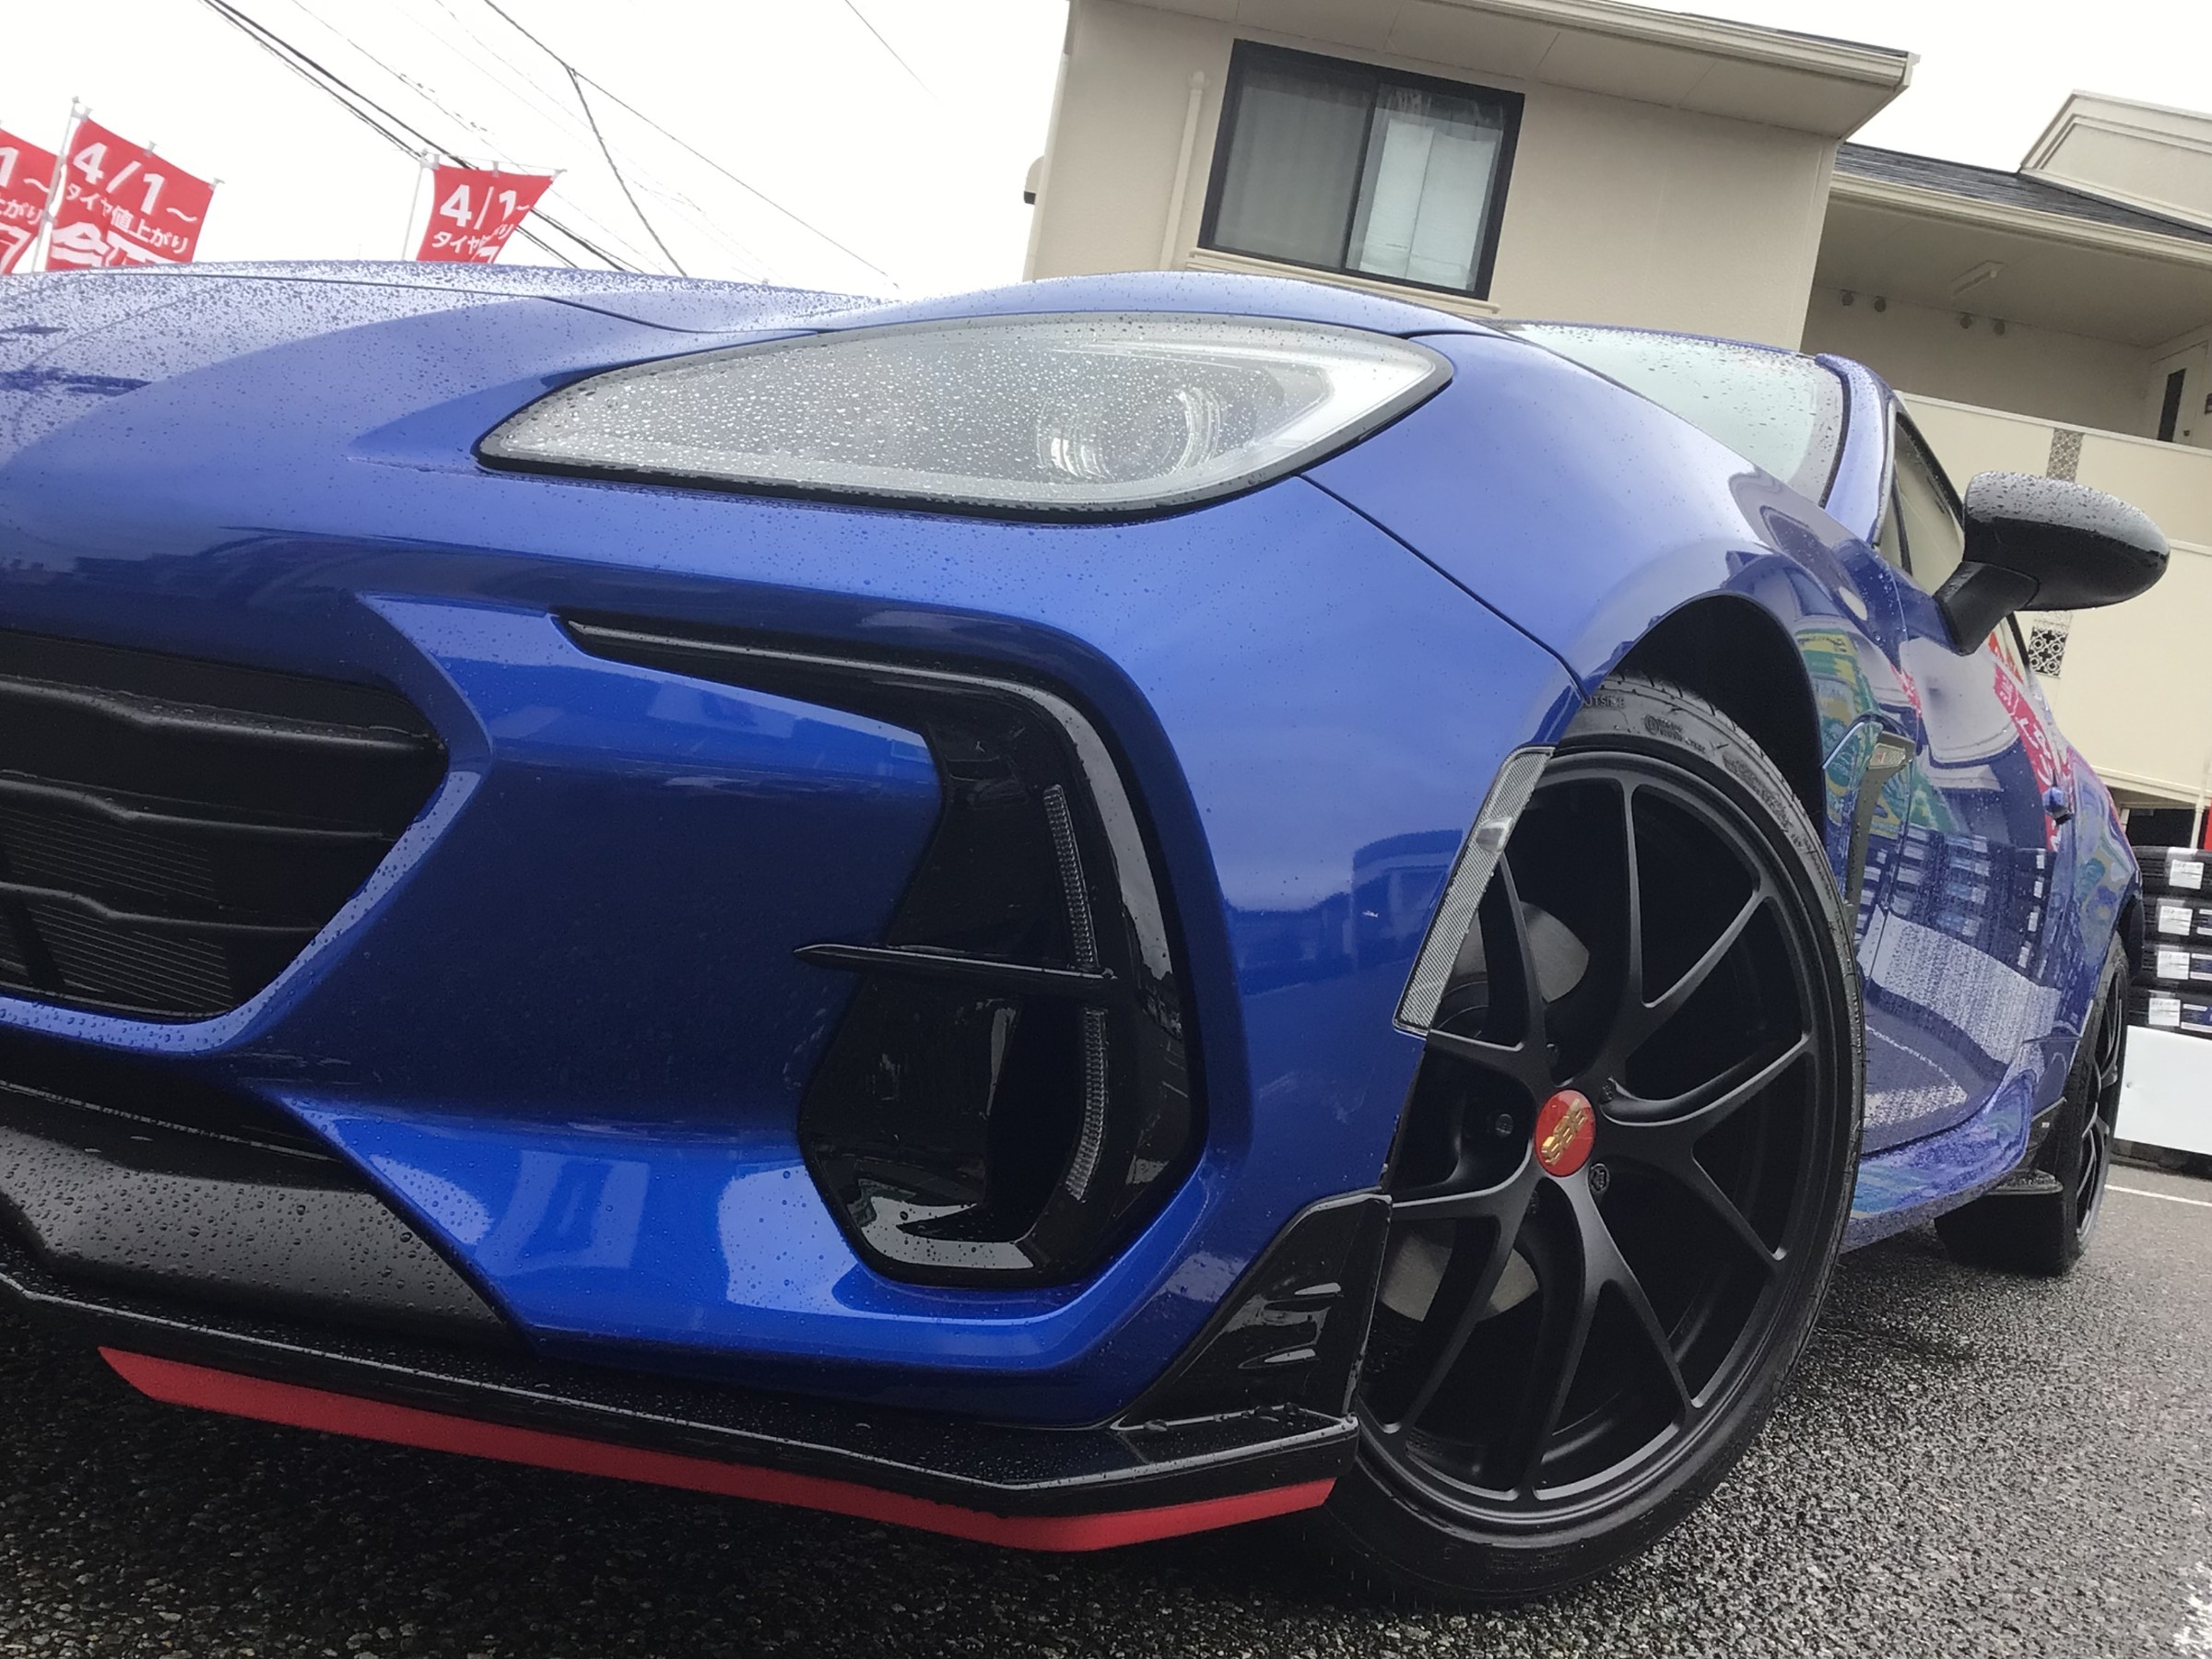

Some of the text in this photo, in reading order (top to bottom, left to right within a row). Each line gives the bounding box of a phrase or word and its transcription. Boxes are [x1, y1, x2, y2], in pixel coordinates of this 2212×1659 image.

[65, 182, 189, 254] タイヤ値上がり
[1582, 694, 1625, 709] UTSIDE
